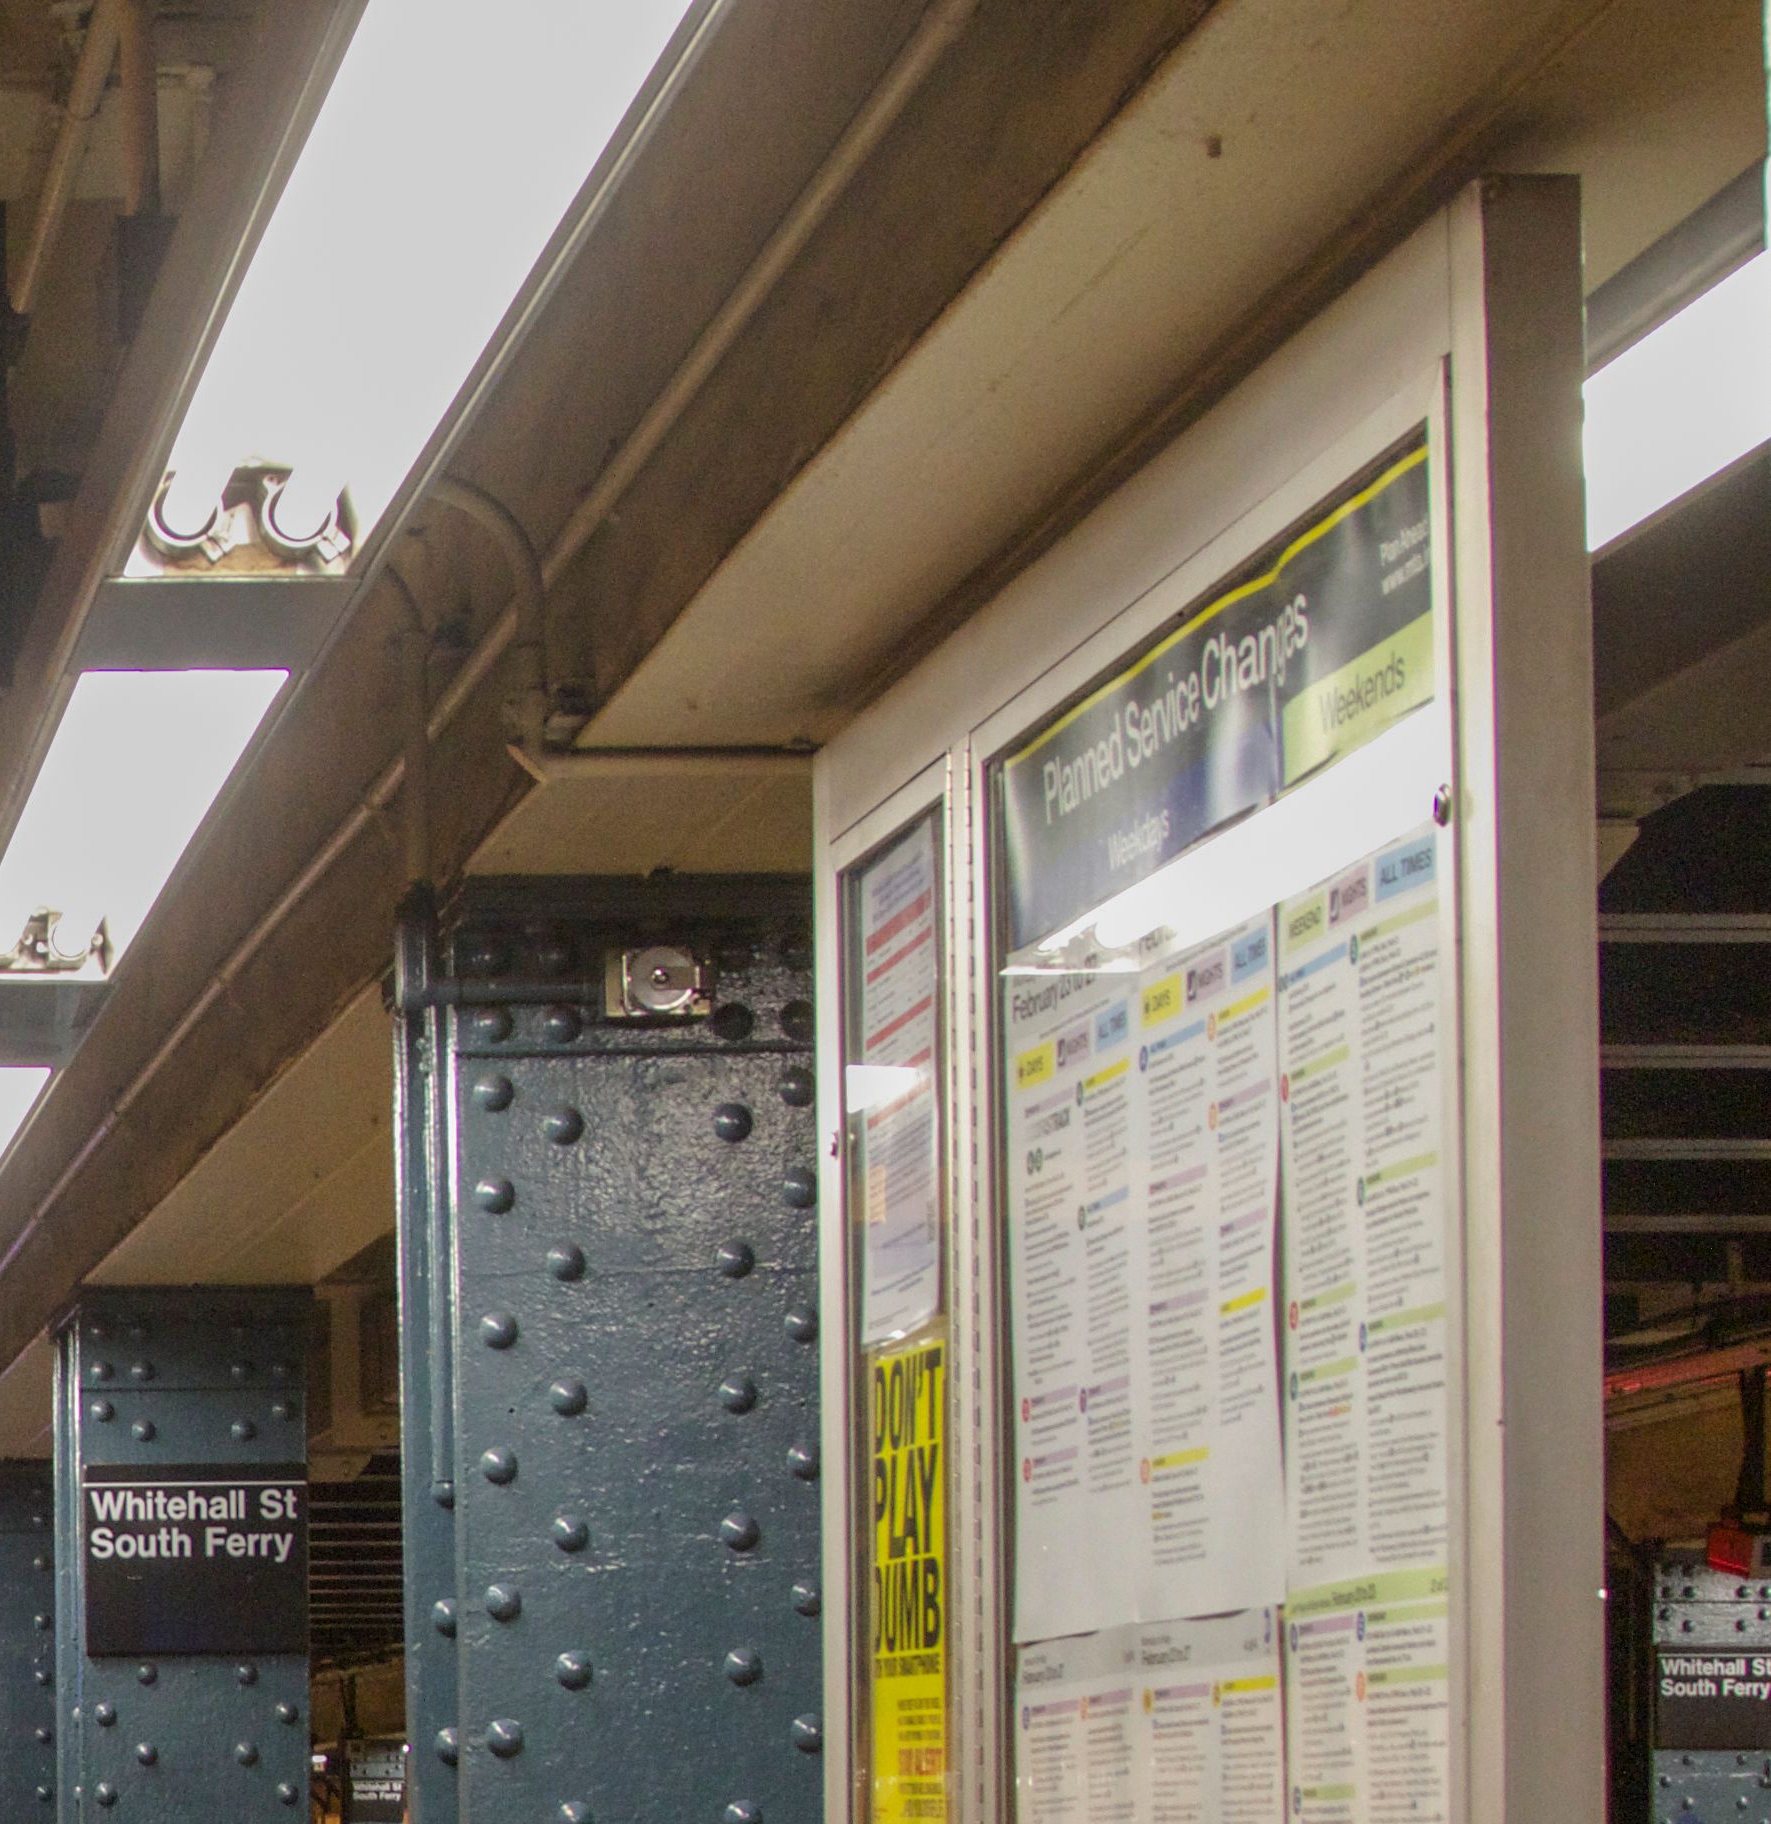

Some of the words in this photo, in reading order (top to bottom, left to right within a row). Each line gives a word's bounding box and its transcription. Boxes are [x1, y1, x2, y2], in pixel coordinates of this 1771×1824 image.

[1043, 713, 1124, 825] Planned
[1125, 670, 1199, 768] Service
[1202, 594, 1308, 711] Changes
[1319, 651, 1406, 734] Weekends
[1108, 809, 1170, 871] Weekdays
[90, 1489, 246, 1521] Whitehall
[260, 1489, 298, 1520] St
[90, 1527, 192, 1558] South
[205, 1526, 293, 1563] Ferry
[1661, 1659, 1746, 1676] Whitehall
[1661, 1679, 1718, 1697] South
[1722, 1679, 1771, 1700] Ferry
